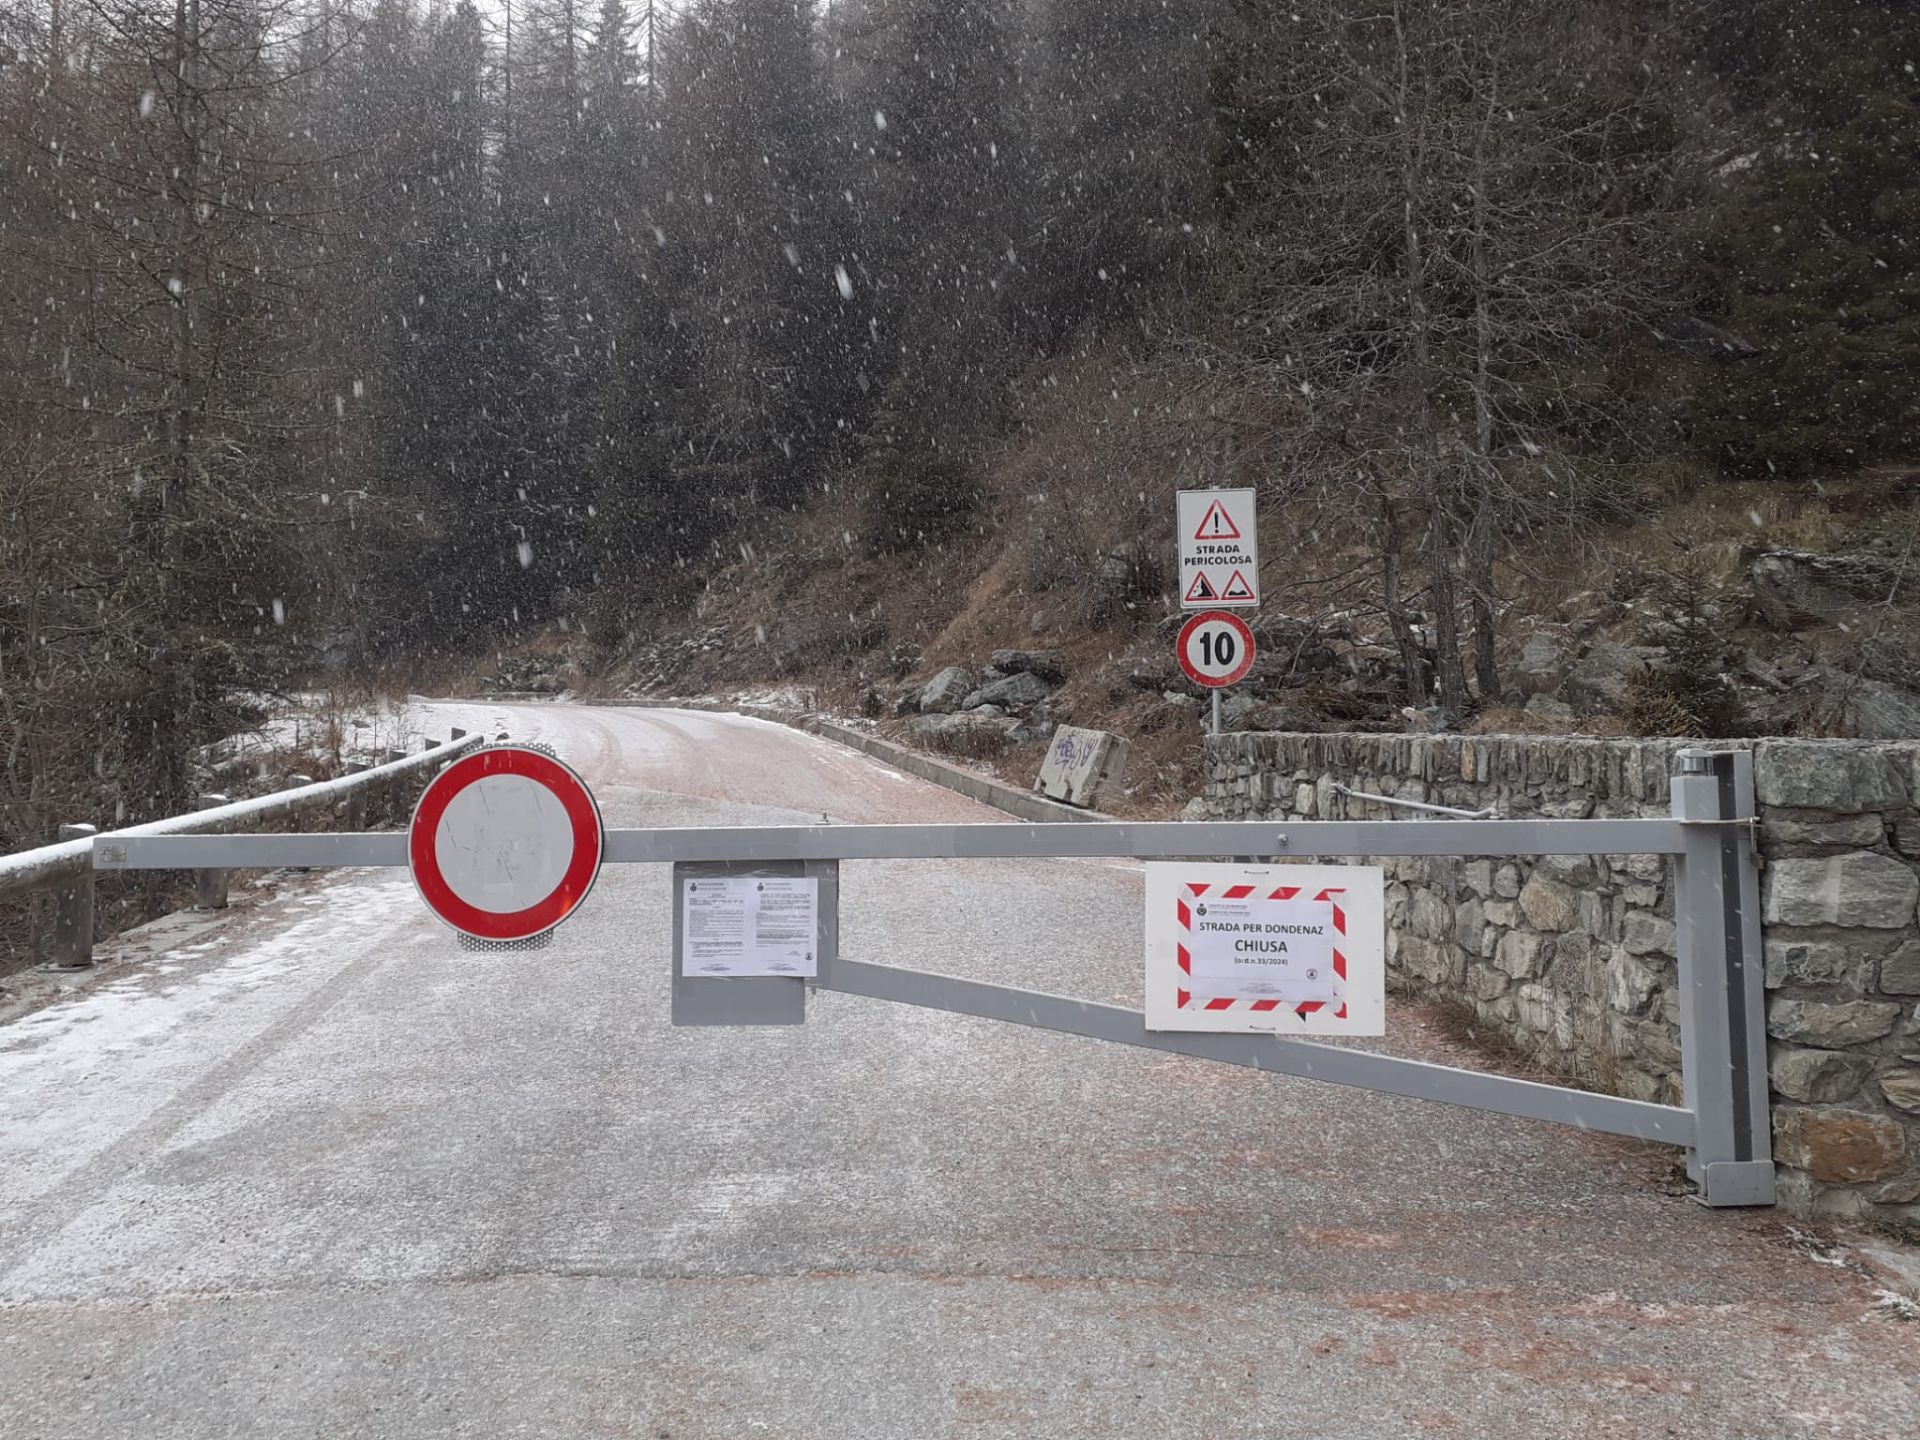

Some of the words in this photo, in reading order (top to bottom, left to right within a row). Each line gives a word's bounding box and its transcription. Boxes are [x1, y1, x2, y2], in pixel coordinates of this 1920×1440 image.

[1196, 545, 1240, 554] STRADA
[1184, 555, 1252, 566] PERICOLOSA
[1199, 631, 1236, 666] 10
[1199, 922, 1240, 932] STRADA
[1243, 923, 1262, 933] PER
[1265, 924, 1324, 935] DONDENAZ
[1235, 939, 1288, 953] CHIUSA
